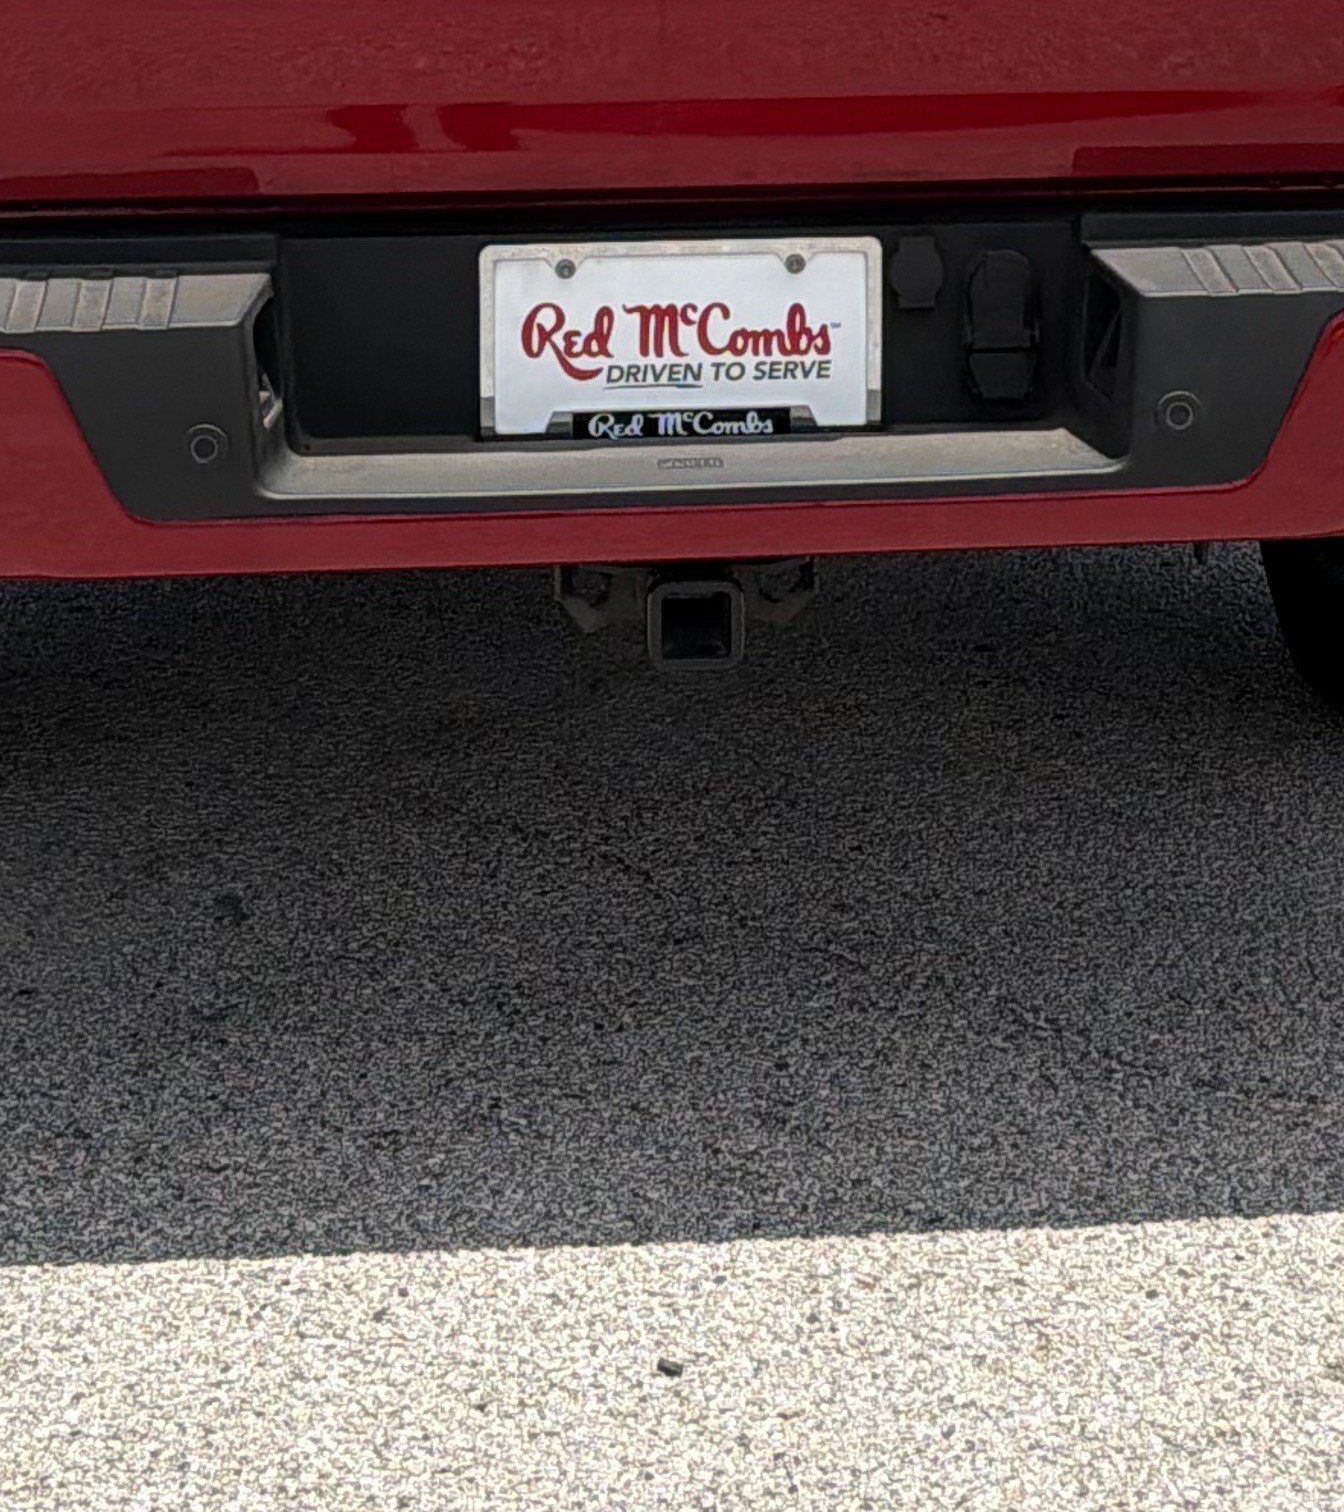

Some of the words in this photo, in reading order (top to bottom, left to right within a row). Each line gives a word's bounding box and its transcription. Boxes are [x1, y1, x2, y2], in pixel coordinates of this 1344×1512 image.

[521, 302, 614, 381] Red
[606, 362, 703, 384] DRIVEN
[710, 361, 745, 381] TO
[755, 359, 832, 380] SERVE
[588, 412, 644, 440] Red
